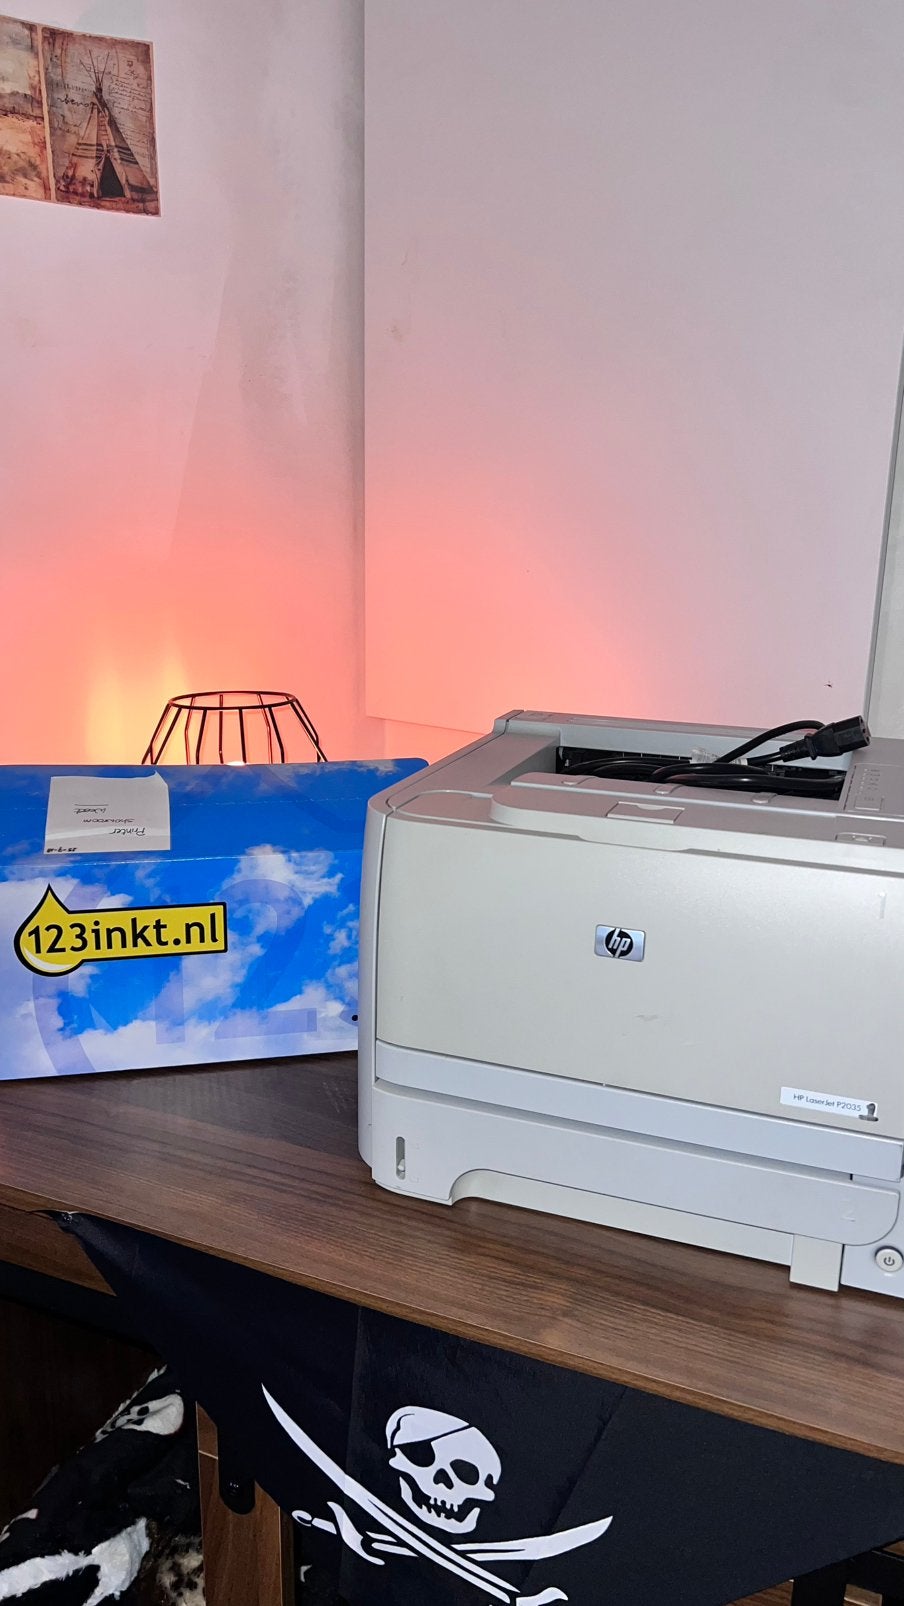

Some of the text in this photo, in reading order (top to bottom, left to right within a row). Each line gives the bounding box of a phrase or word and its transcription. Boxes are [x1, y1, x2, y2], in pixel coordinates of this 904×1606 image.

[108, 827, 146, 837] Printer
[28, 912, 219, 954] 123inkt.nl
[606, 928, 632, 958] hp
[793, 1093, 862, 1112] HP LaserJet P2035
